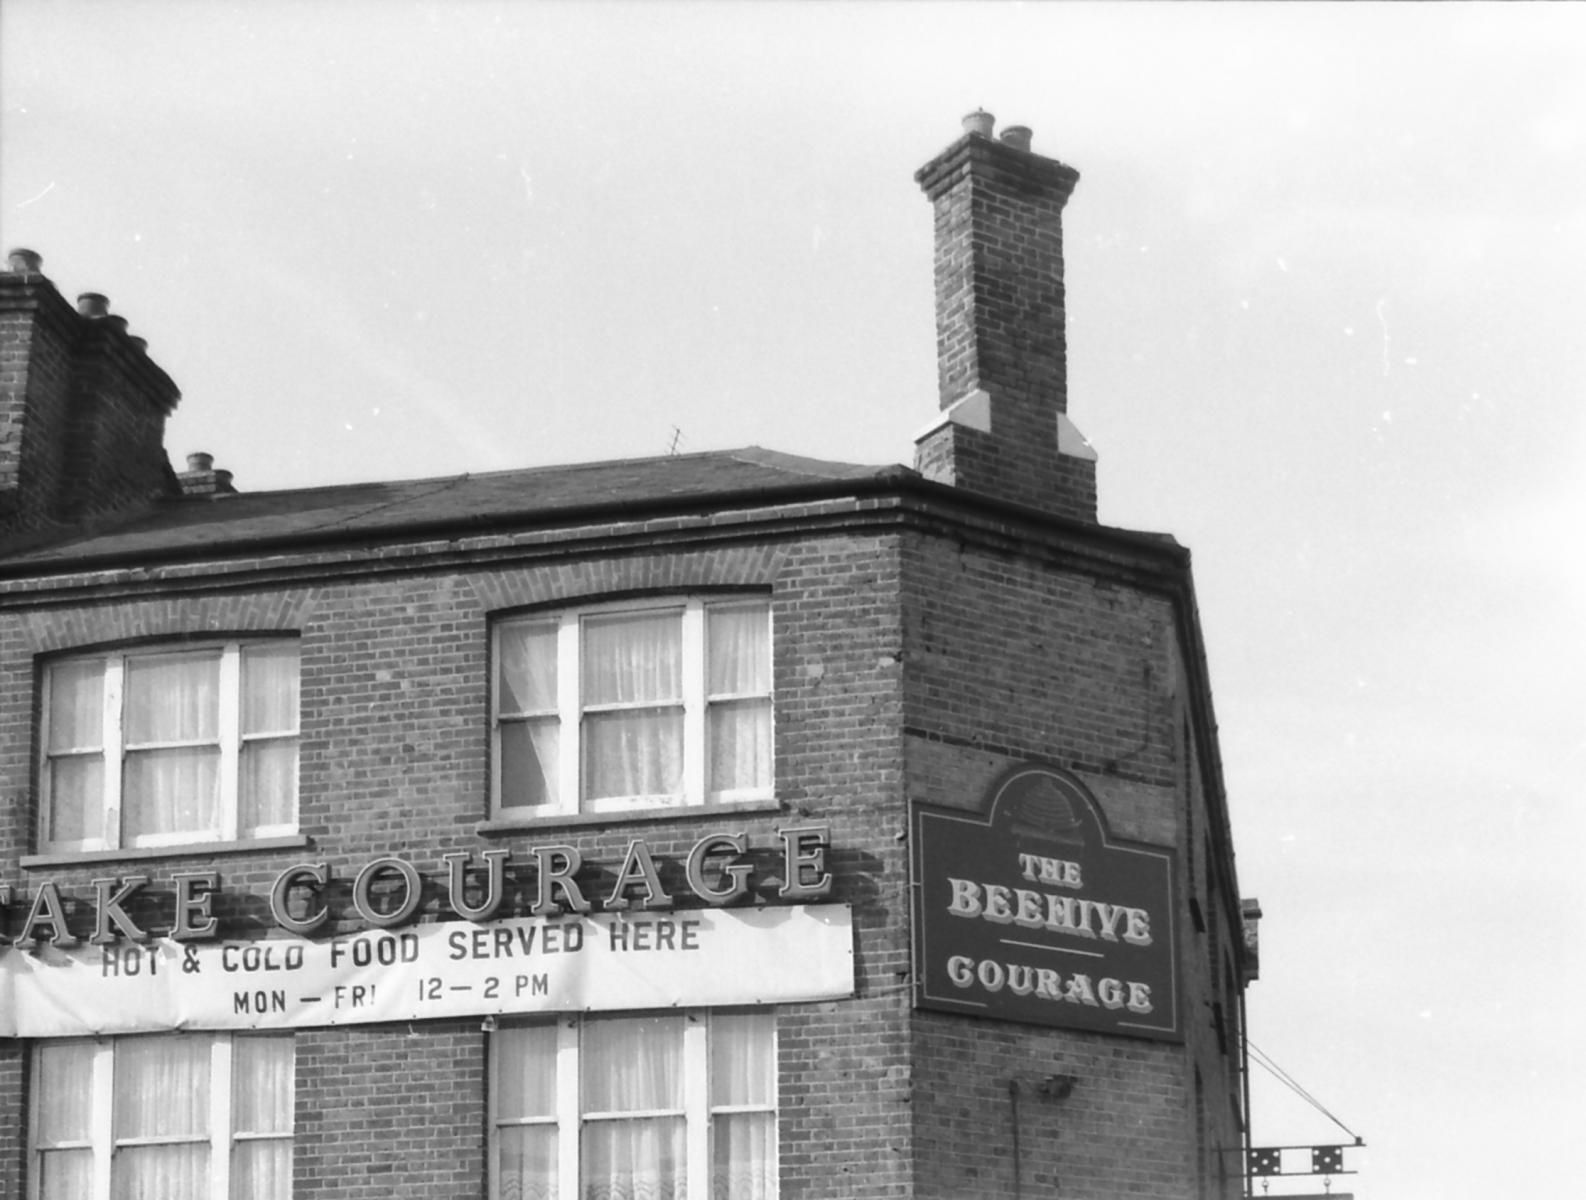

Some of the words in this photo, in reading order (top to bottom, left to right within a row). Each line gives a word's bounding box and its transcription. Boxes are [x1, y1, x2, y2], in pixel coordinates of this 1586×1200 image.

[0, 871, 218, 948] AKE
[269, 825, 834, 936] COURAGE
[1018, 853, 1084, 890] THE
[946, 877, 1154, 947] BEEHIVE
[101, 945, 162, 977] HOT
[182, 944, 202, 973] &
[222, 944, 304, 972] COLD
[330, 933, 420, 968] FOOD
[448, 922, 585, 961] SERVED
[609, 919, 701, 953] HERE
[233, 989, 287, 1014] MON
[334, 984, 376, 1009] FRI
[515, 972, 550, 997] PM
[946, 955, 1155, 1015] COURAGE
